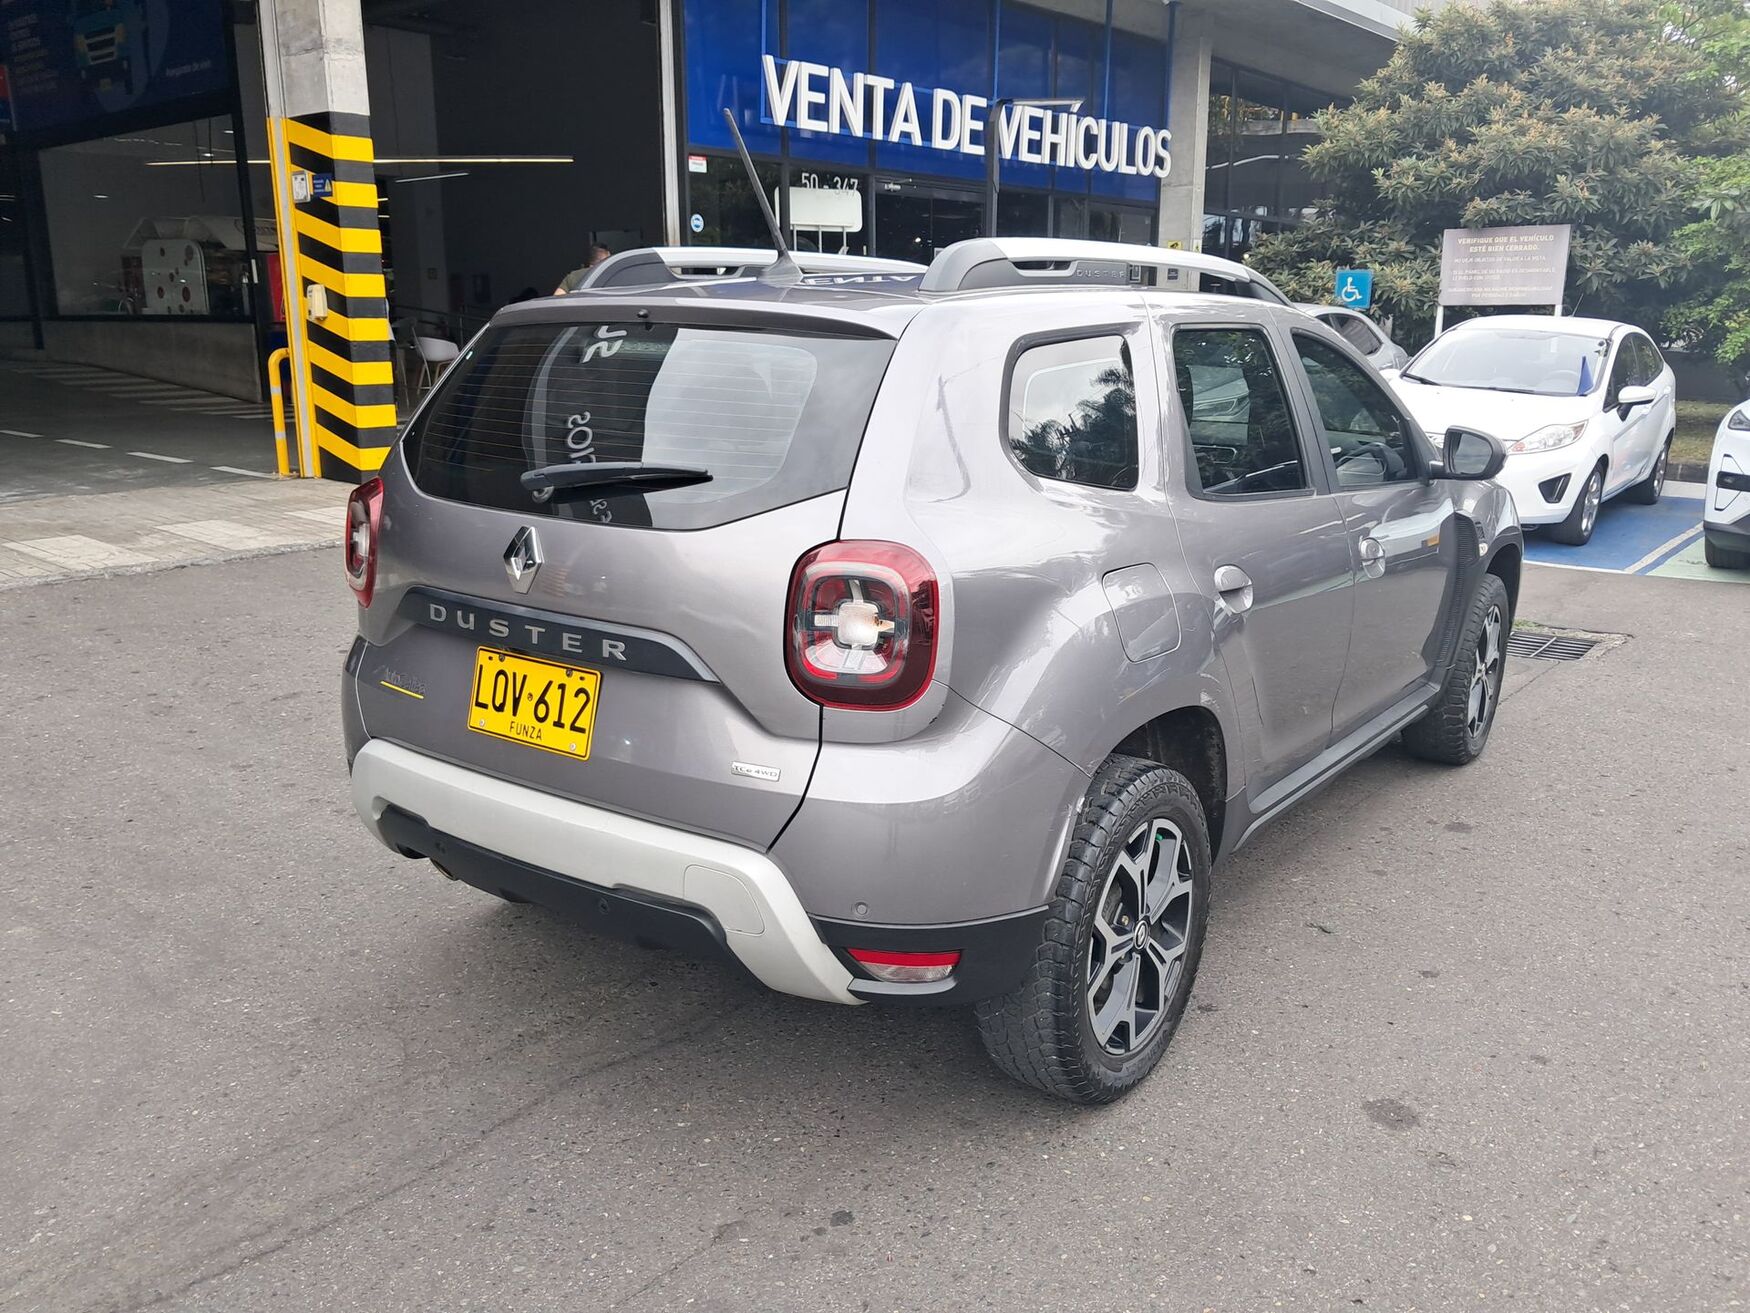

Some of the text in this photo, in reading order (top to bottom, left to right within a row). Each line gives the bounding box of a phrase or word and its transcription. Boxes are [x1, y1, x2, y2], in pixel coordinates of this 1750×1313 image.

[762, 54, 1172, 178] VENTA DE VEHÍCULOS
[1458, 237, 1494, 245] VERIFIQUE
[1520, 233, 1554, 242] VEHÍCULO
[1487, 244, 1504, 252] BIEN
[1076, 269, 1125, 278] DUSTER
[430, 603, 627, 661] DUSTER
[509, 721, 542, 740] FUNZA
